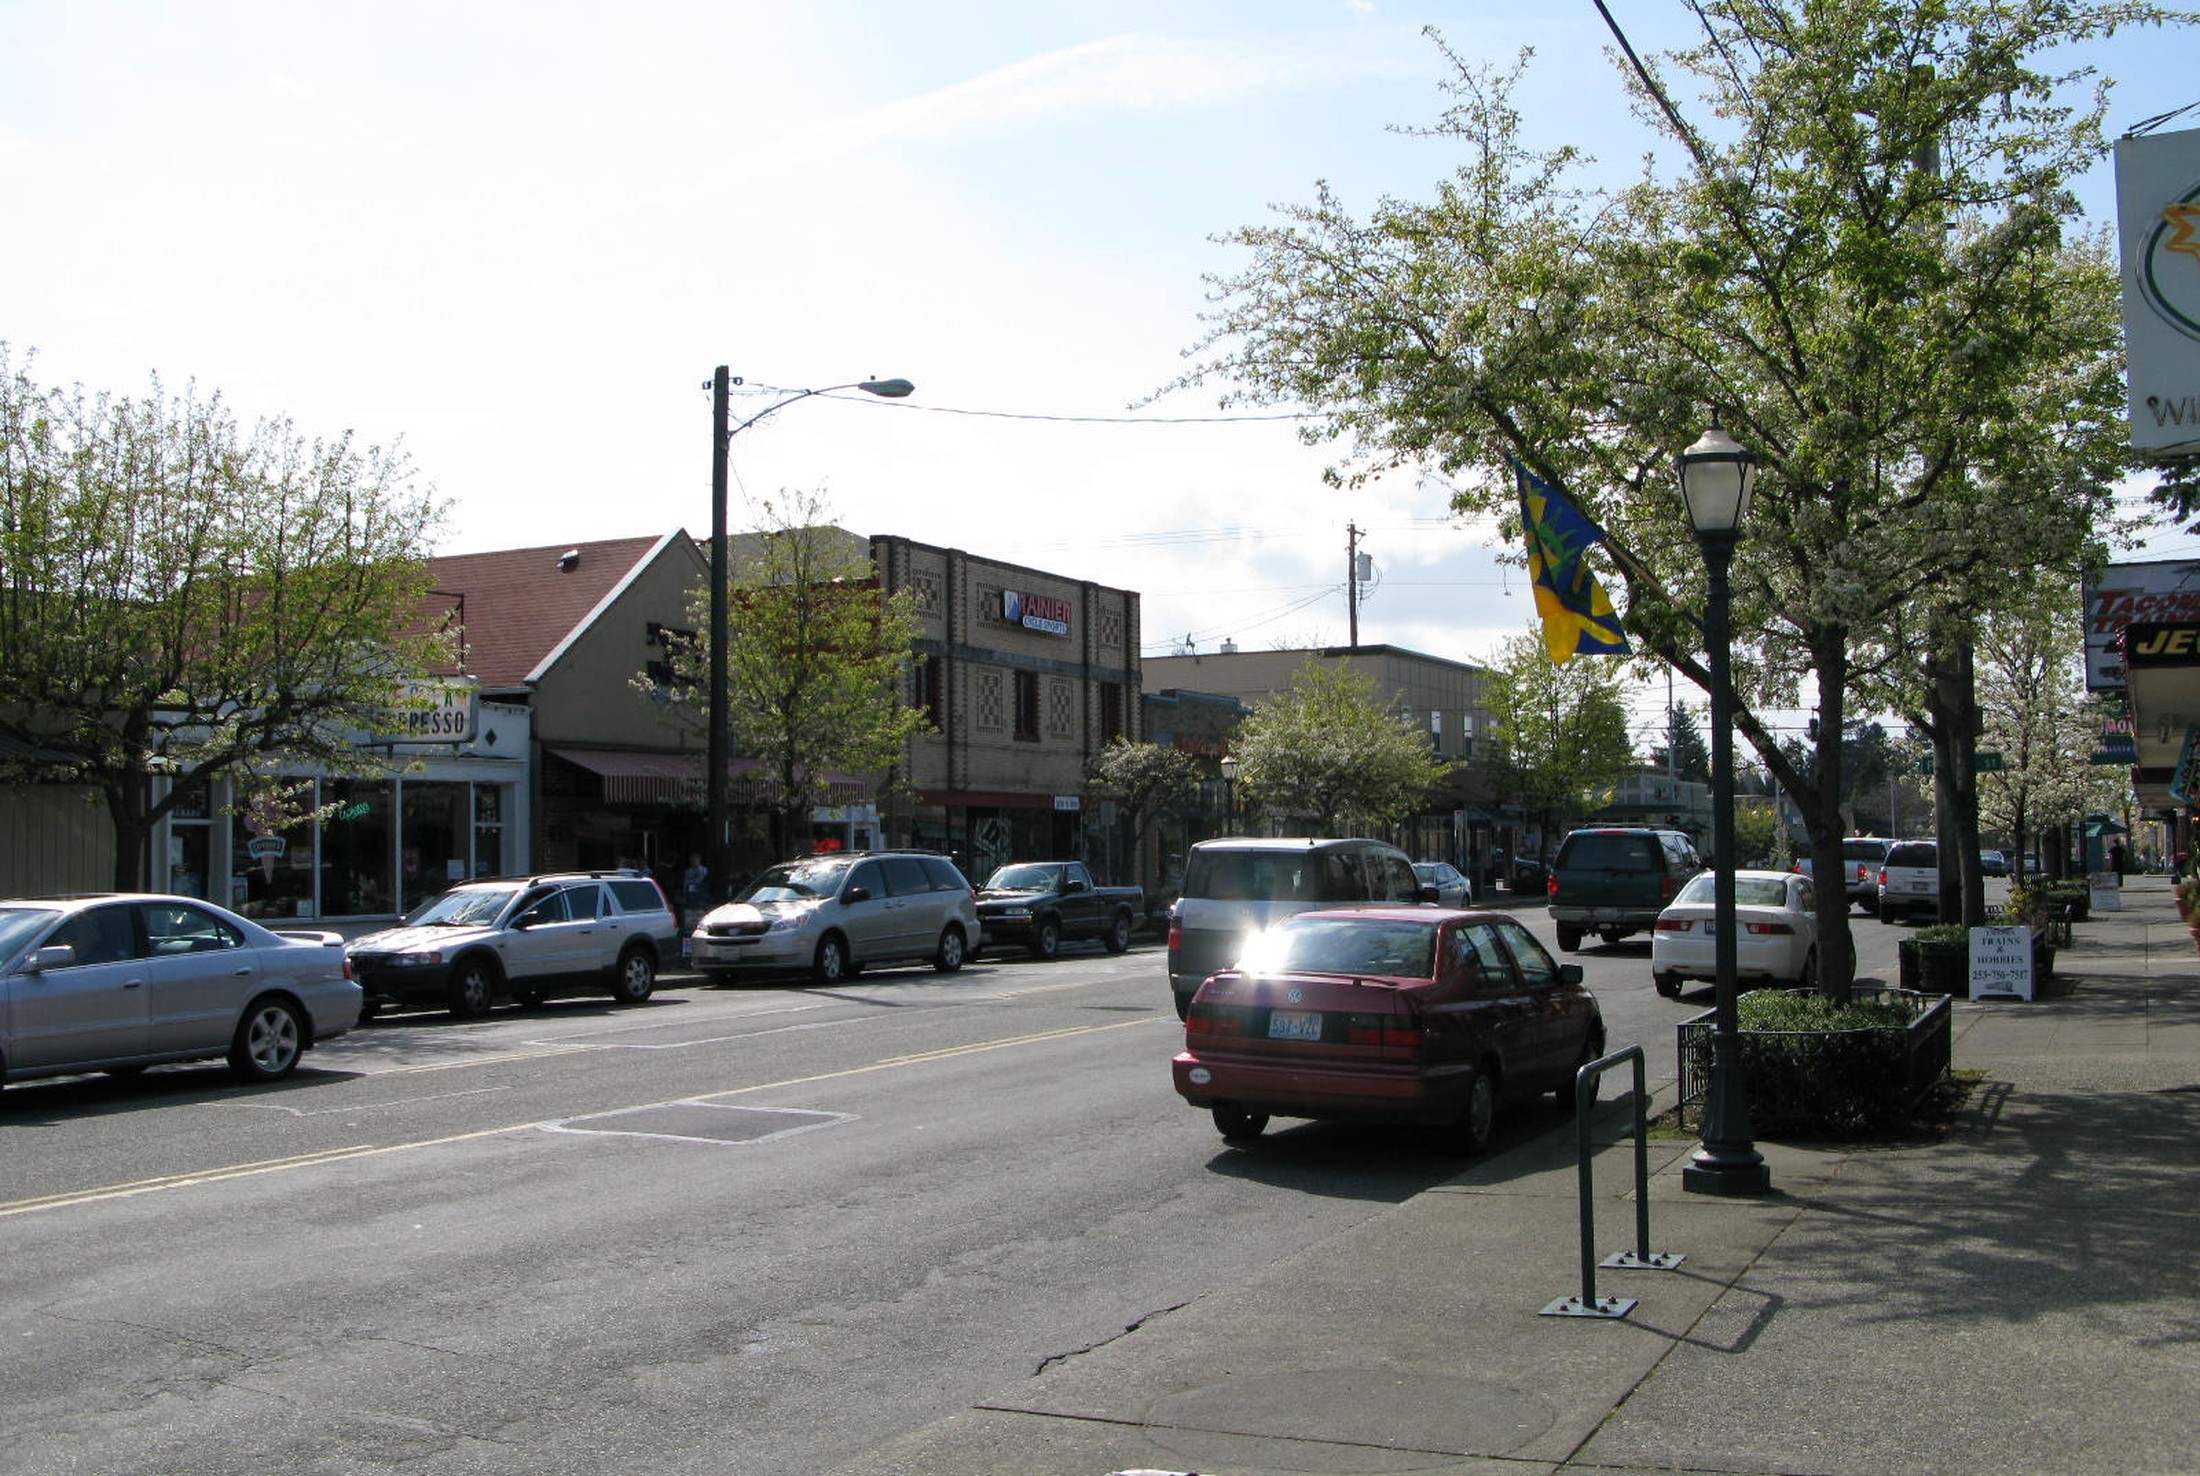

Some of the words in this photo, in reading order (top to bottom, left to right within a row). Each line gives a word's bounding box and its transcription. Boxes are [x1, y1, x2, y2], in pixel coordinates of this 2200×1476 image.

[1018, 592, 1072, 621] RAINIER
[2097, 589, 2200, 613] TACOM
[2135, 630, 2200, 655] JE
[1980, 937, 2021, 945] TRAINS
